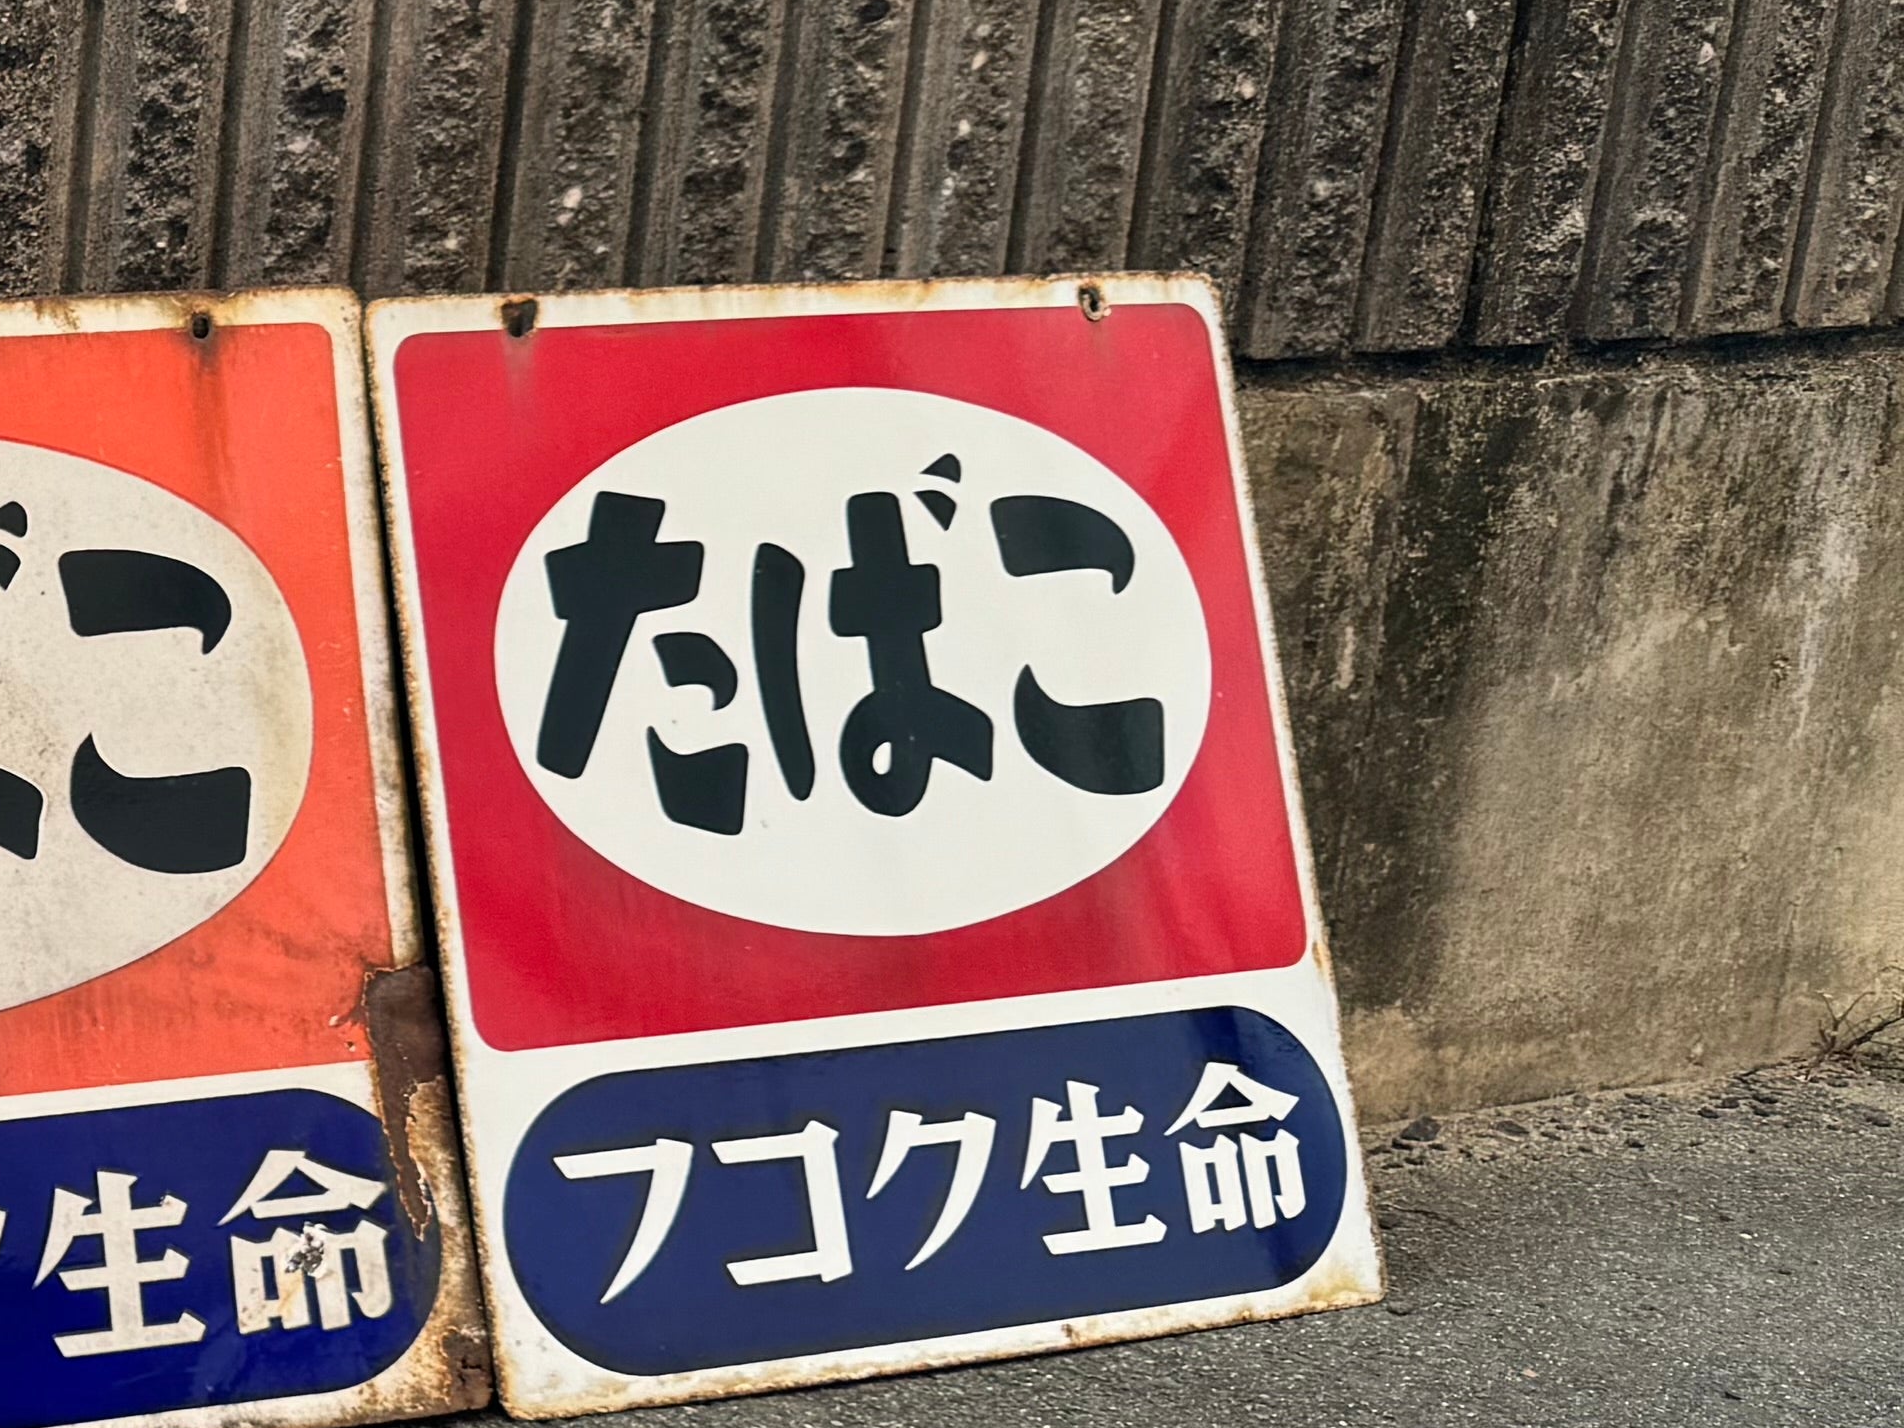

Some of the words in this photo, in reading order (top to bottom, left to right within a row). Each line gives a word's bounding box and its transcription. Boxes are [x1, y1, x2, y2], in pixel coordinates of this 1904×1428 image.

[536, 453, 1165, 836] たばこ
[552, 1061, 1308, 1306] フコク生命
